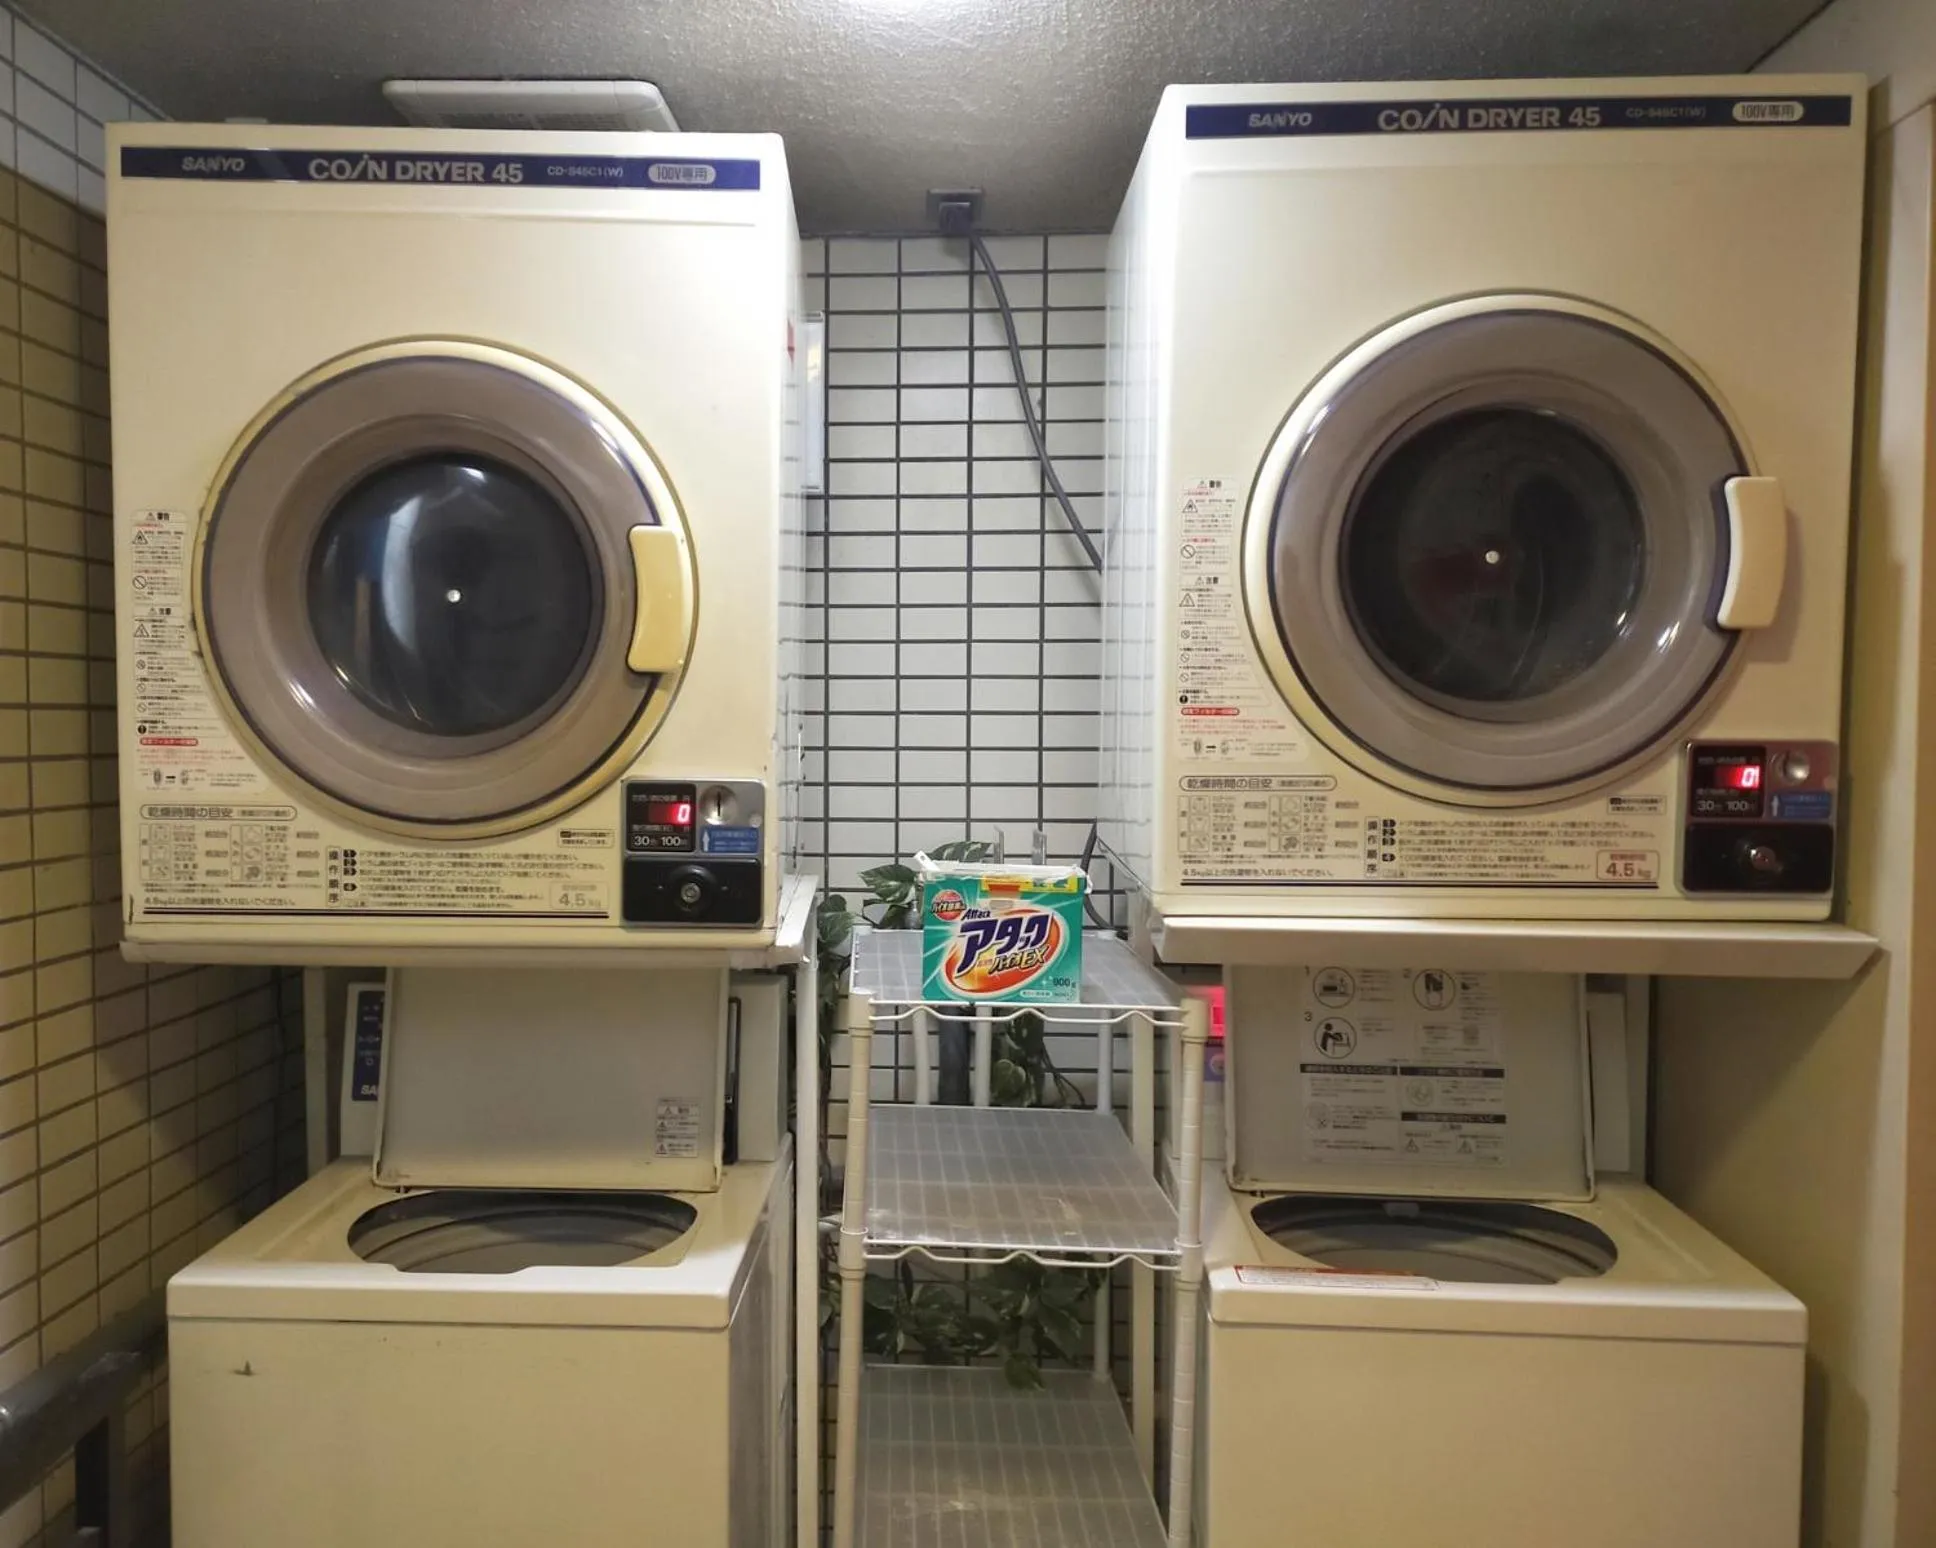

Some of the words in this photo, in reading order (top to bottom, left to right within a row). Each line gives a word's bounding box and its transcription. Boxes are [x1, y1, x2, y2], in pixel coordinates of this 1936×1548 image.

[1248, 112, 1313, 128] SANYO
[1377, 102, 1459, 131] COIN
[1467, 108, 1560, 130] DRYER
[1568, 106, 1601, 127] 45
[181, 156, 246, 173] SANYO
[308, 154, 387, 181] COIN
[394, 159, 485, 183] DRYER
[491, 163, 523, 184] 45
[677, 803, 691, 823] 0
[961, 909, 991, 921] Attack
[955, 914, 1051, 976] アタック
[1303, 1011, 1313, 1022] 3
